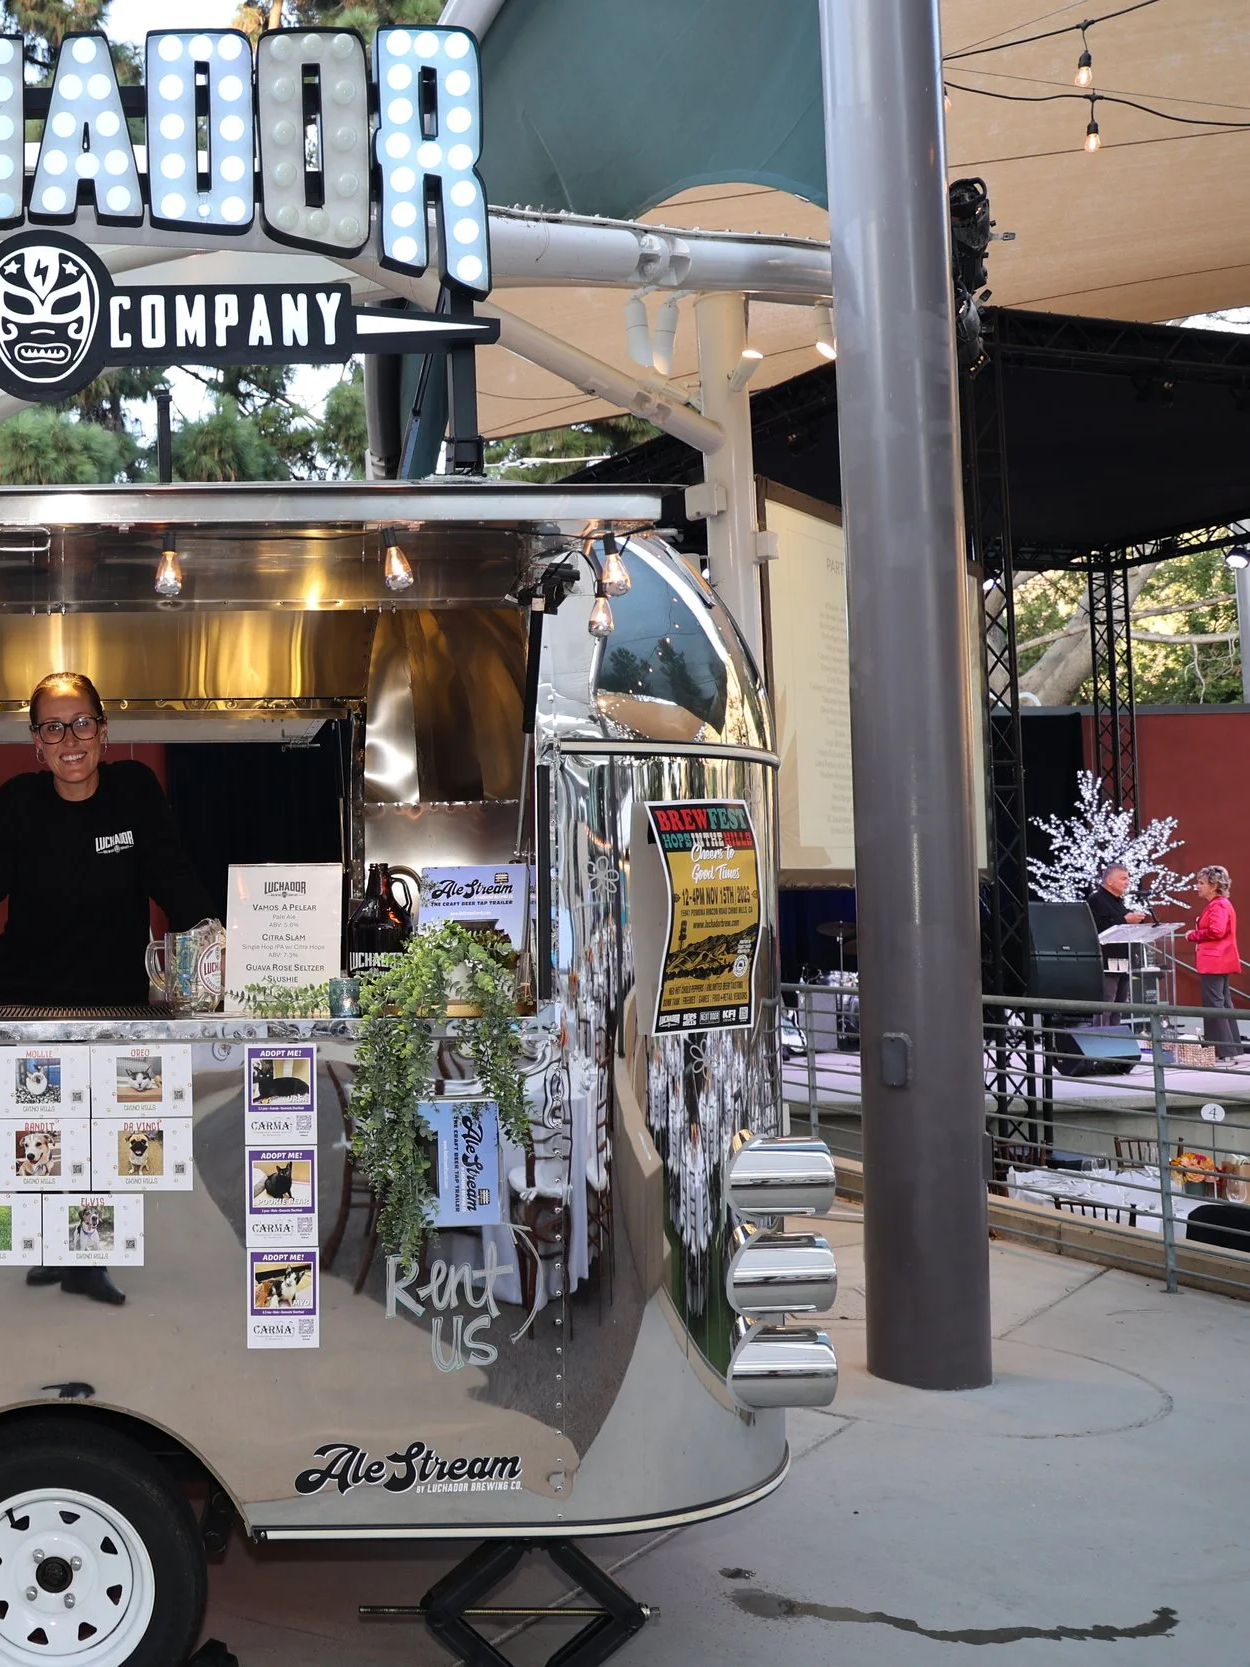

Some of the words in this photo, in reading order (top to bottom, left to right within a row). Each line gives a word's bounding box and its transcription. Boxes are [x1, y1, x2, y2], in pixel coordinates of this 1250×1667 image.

[109, 292, 340, 349] COMPANY
[95, 830, 134, 852] LUCHADOR
[662, 833, 692, 849] HOPS
[691, 845, 724, 863] Cheers
[725, 844, 735, 860] to
[692, 863, 715, 884] Good
[716, 863, 740, 880] Times
[264, 881, 306, 895] LUCHADOR
[706, 886, 718, 905] NOV
[720, 886, 734, 904] 15TH
[26, 1050, 53, 1058] MOLLIE
[130, 1049, 150, 1057] OREO
[1208, 1107, 1218, 1119] 4
[80, 1197, 105, 1206] ELVIS
[385, 1240, 514, 1319] Rent
[427, 1483, 468, 1493] LUCHADOR
[470, 1481, 508, 1492] BREWING
[510, 1480, 523, 1490] CO.
